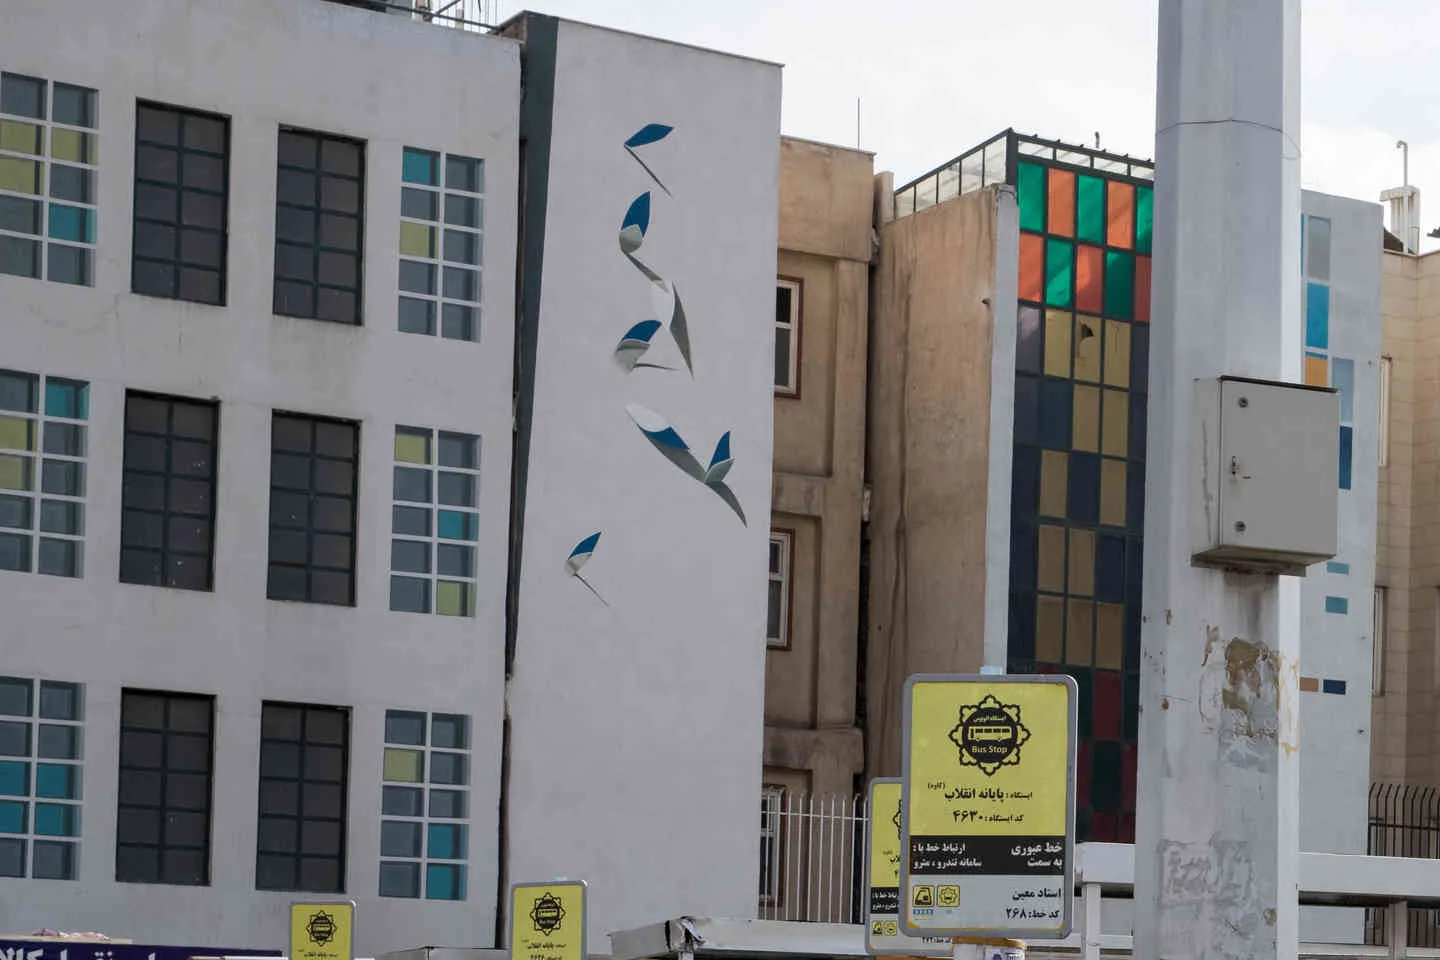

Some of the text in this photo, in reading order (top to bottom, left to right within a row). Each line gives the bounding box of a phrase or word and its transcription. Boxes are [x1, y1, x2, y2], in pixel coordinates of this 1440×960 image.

[972, 745, 1008, 753] Bus Stop
[944, 787, 976, 802] انقلاب
[978, 787, 1004, 803] پایانه
[953, 810, 983, 823] ۴۶۳۰
[925, 843, 940, 852] خط
[942, 843, 966, 855] ارتباط
[1010, 842, 1063, 856] خط عبوری
[1027, 858, 1063, 869] به سمت
[1012, 887, 1062, 901] استاد معین
[1048, 909, 1060, 918] کد
